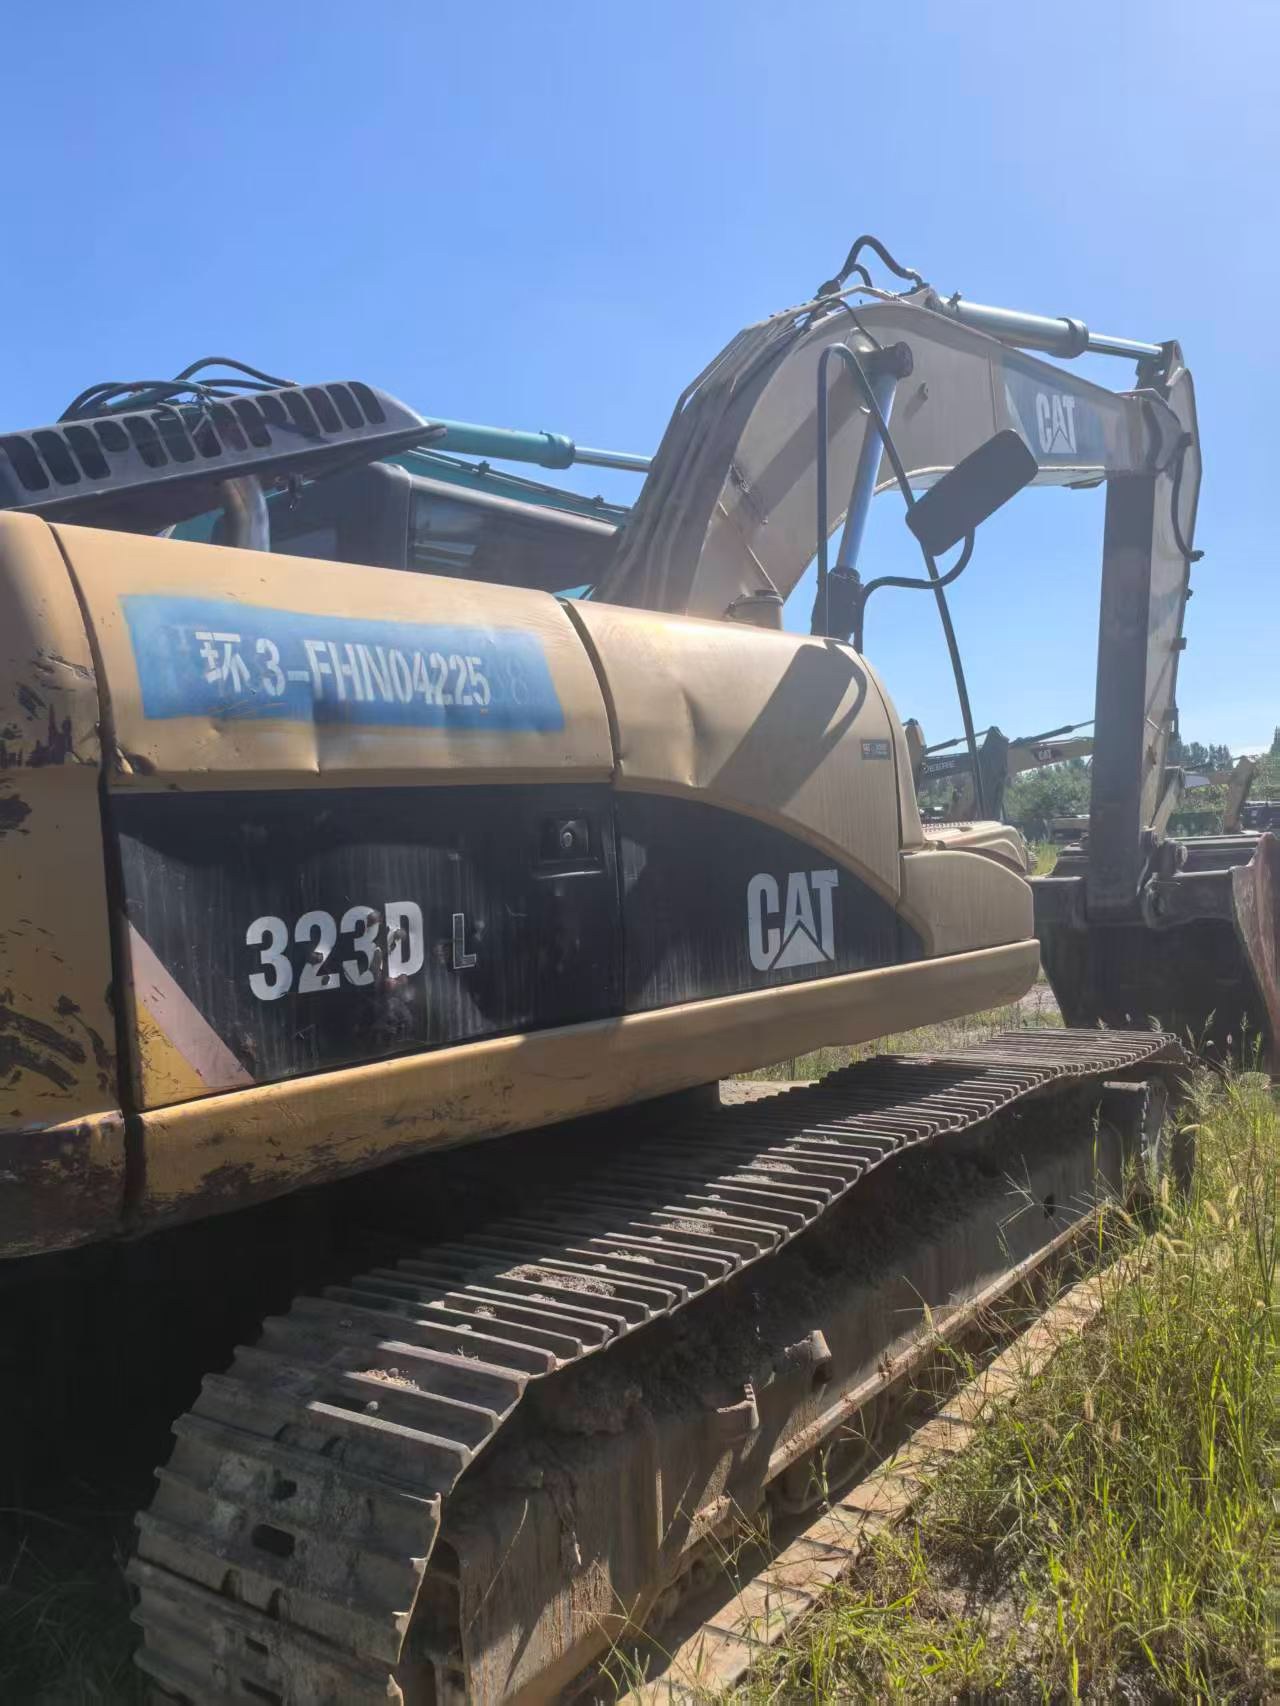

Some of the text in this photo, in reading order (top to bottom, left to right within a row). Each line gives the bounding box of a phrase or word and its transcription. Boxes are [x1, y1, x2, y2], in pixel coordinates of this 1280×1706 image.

[1035, 392, 1077, 454] CAT
[246, 901, 477, 1001] 323D L
[747, 869, 839, 971] CAT
